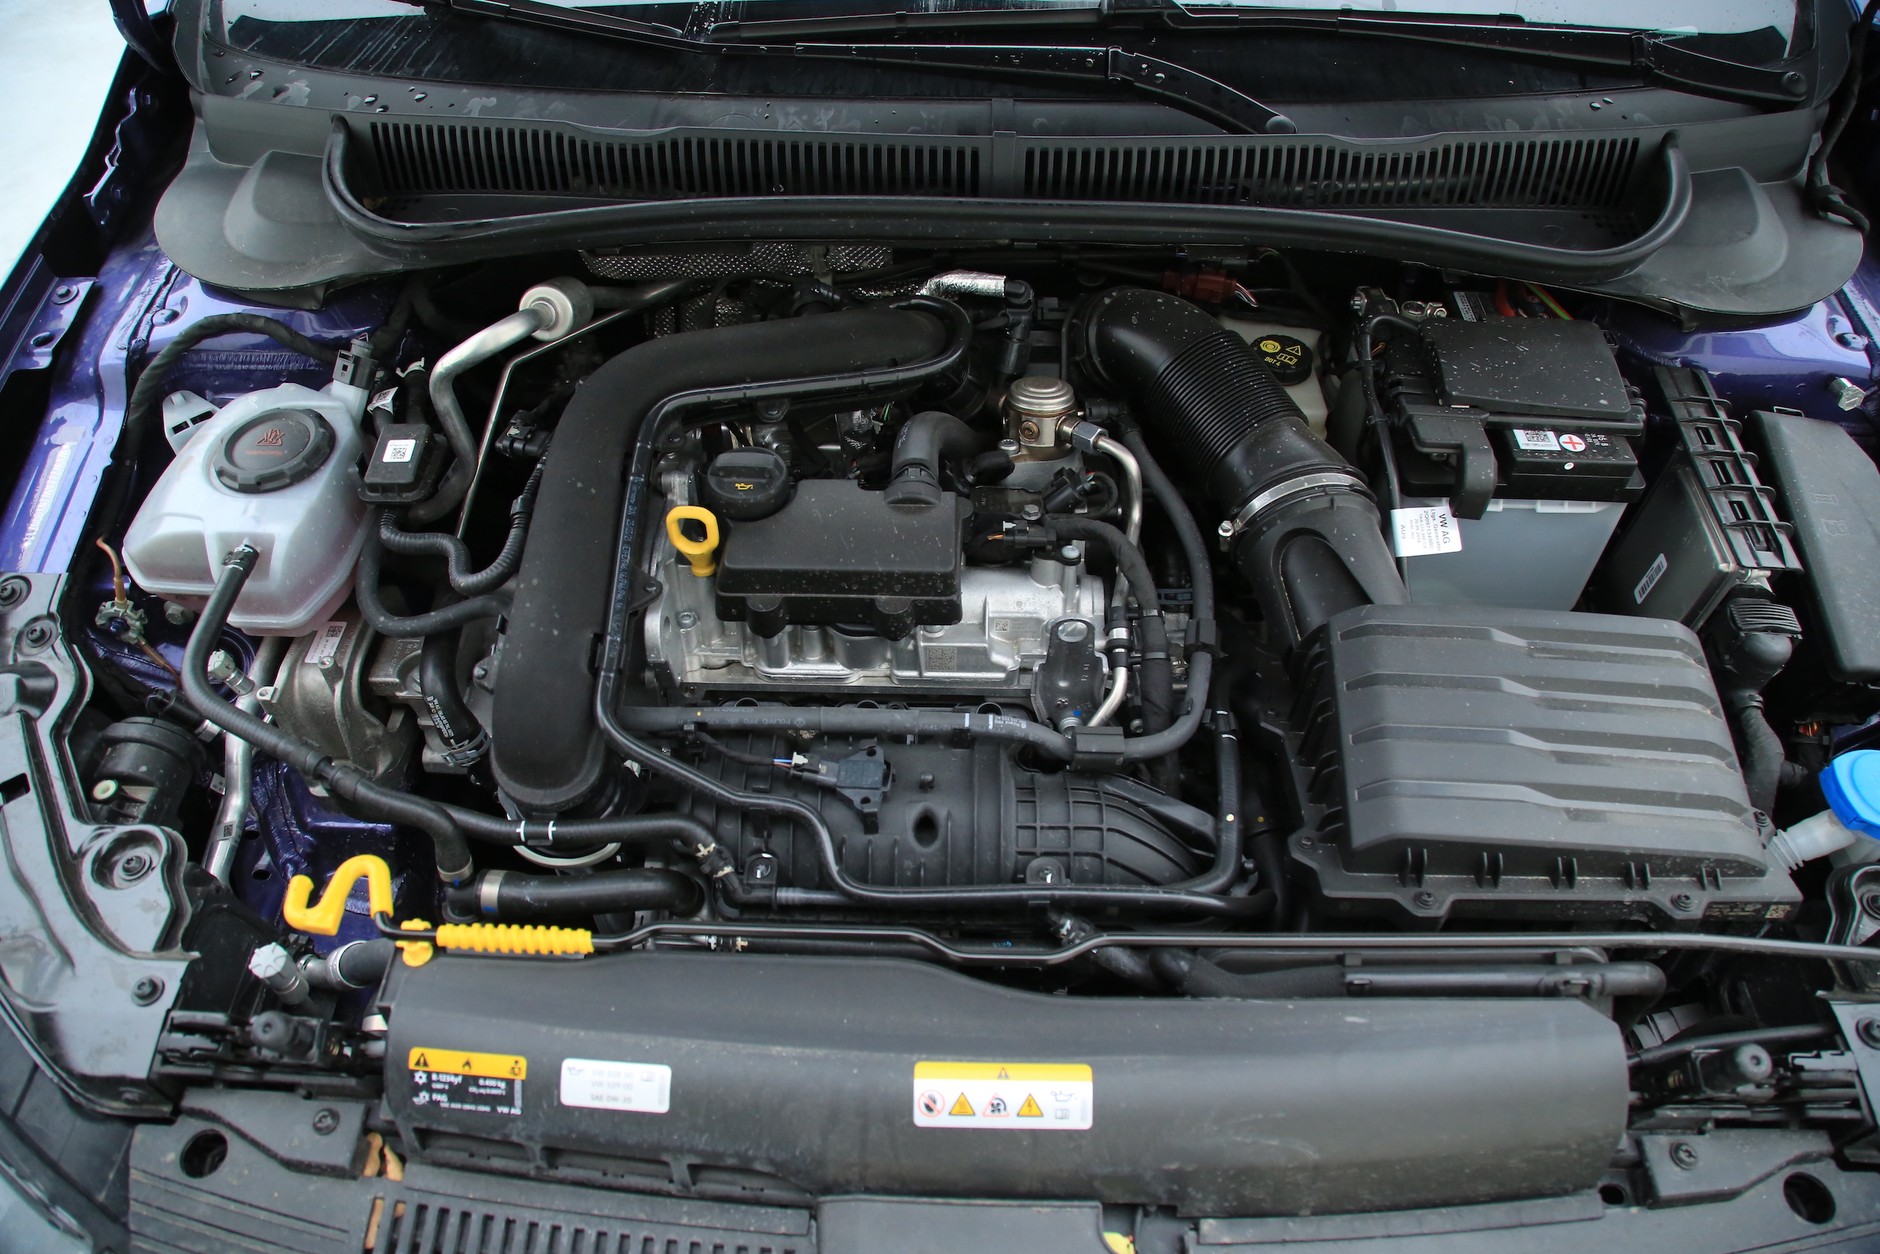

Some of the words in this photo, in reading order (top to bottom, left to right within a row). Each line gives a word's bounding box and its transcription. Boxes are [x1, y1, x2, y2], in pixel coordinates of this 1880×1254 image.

[1264, 356, 1277, 364] DOT
[1438, 513, 1448, 528] VW
[1441, 530, 1451, 544] AG
[431, 1093, 449, 1103] PAG
[496, 1105, 510, 1114] VW
